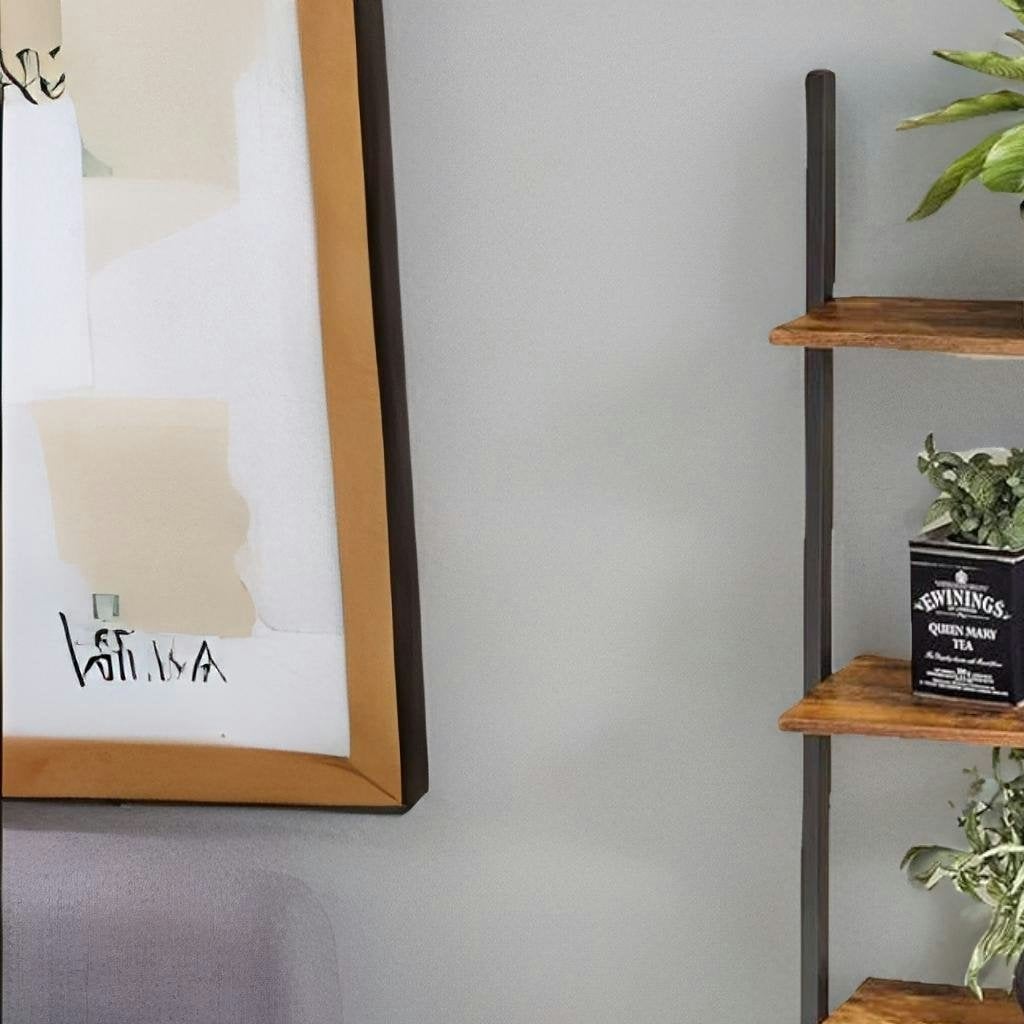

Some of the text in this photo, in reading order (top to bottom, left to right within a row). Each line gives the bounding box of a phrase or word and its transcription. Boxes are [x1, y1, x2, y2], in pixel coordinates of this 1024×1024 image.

[928, 622, 998, 640] QUEEN MARY
[952, 638, 974, 651] TEA
